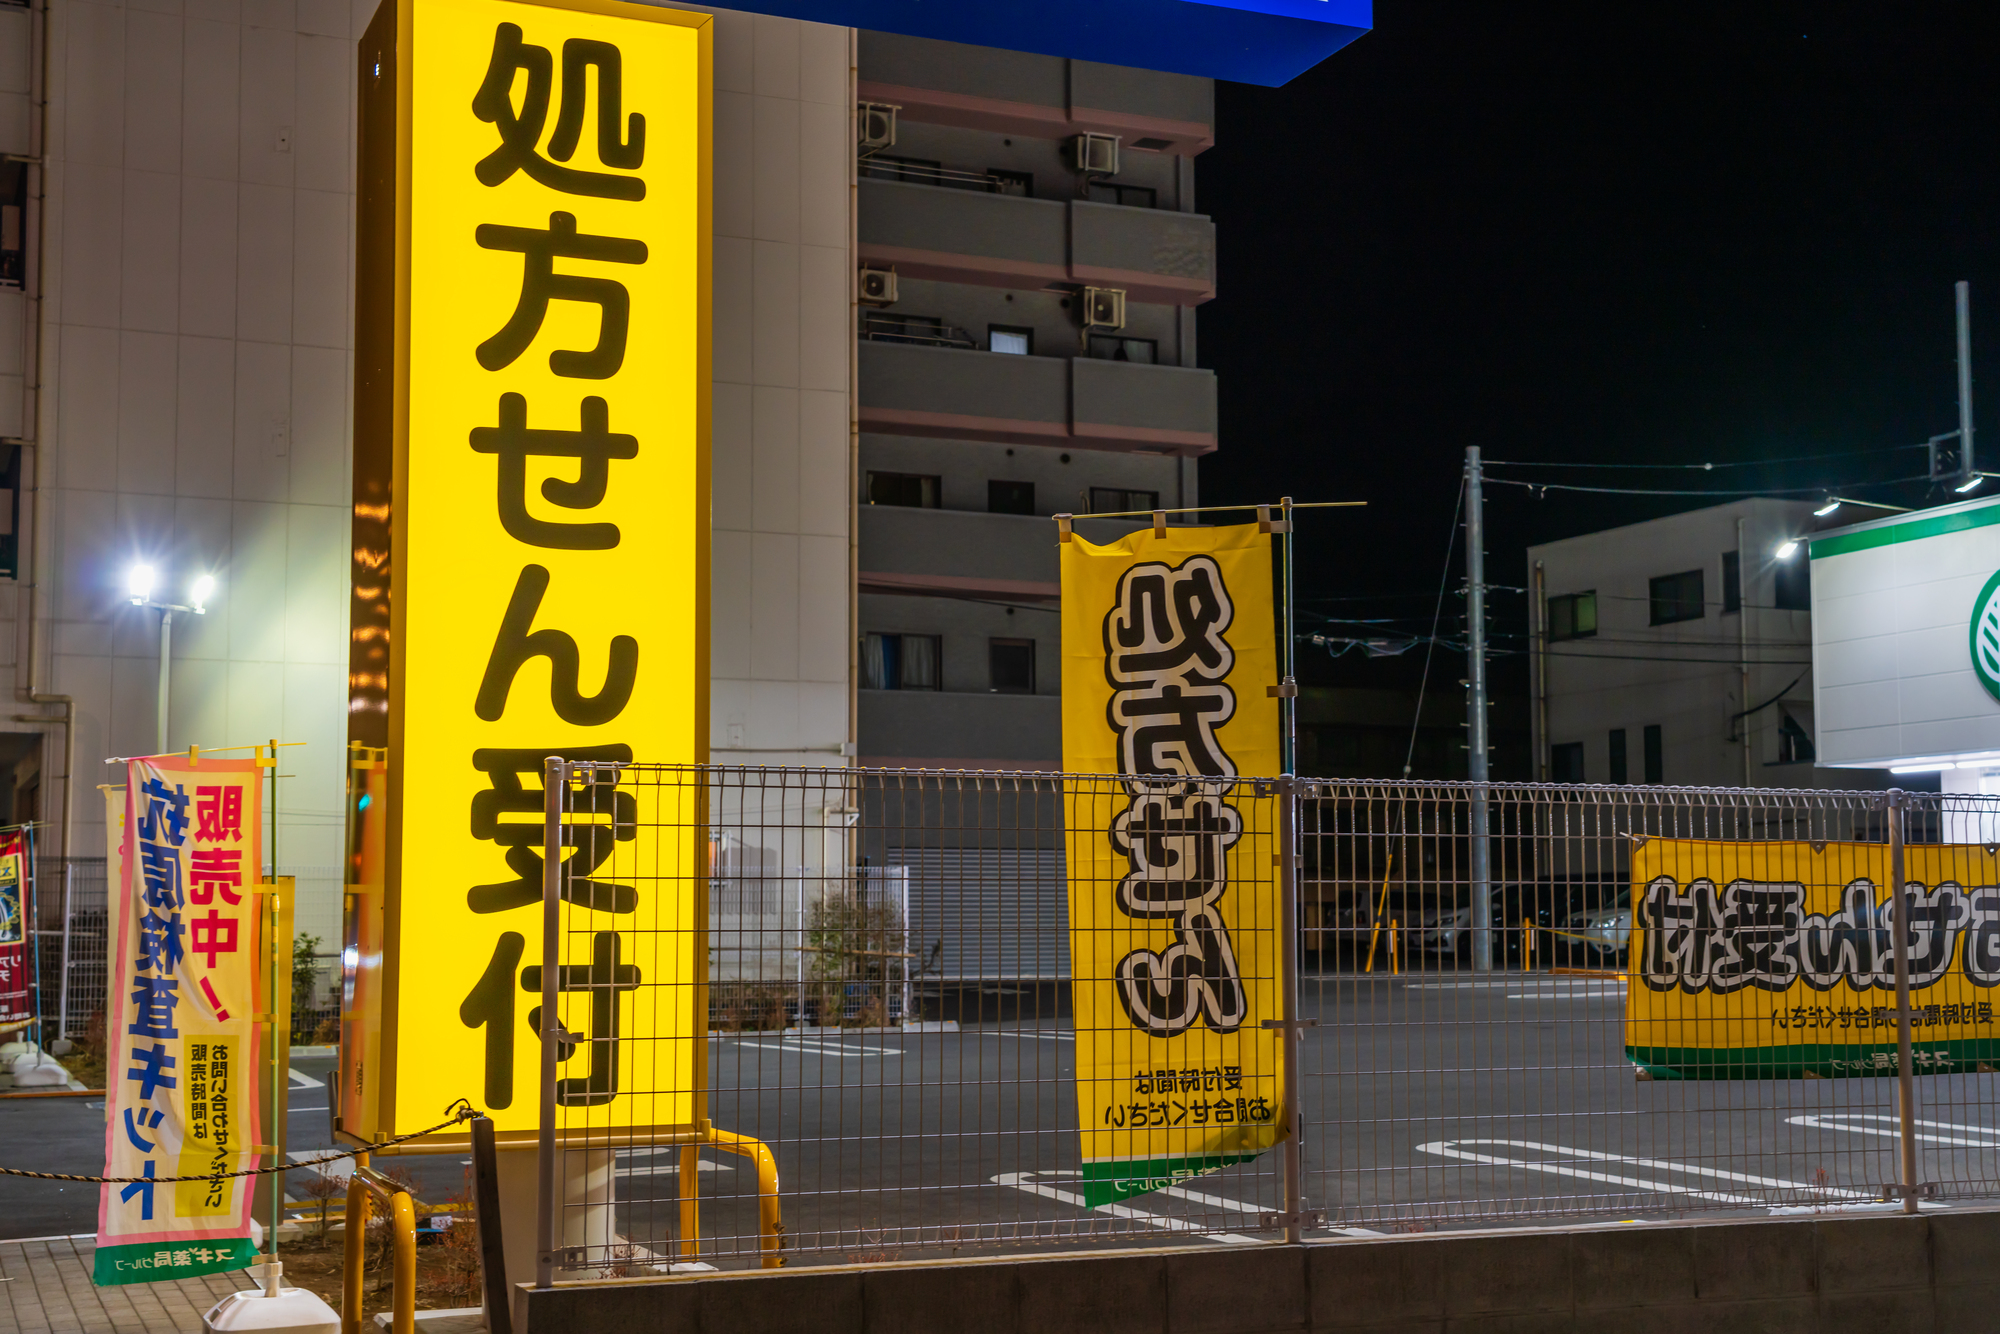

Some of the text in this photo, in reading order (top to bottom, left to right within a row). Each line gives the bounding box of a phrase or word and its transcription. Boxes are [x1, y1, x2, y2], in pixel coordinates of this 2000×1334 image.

[460, 22, 649, 1110] 処方せん受付
